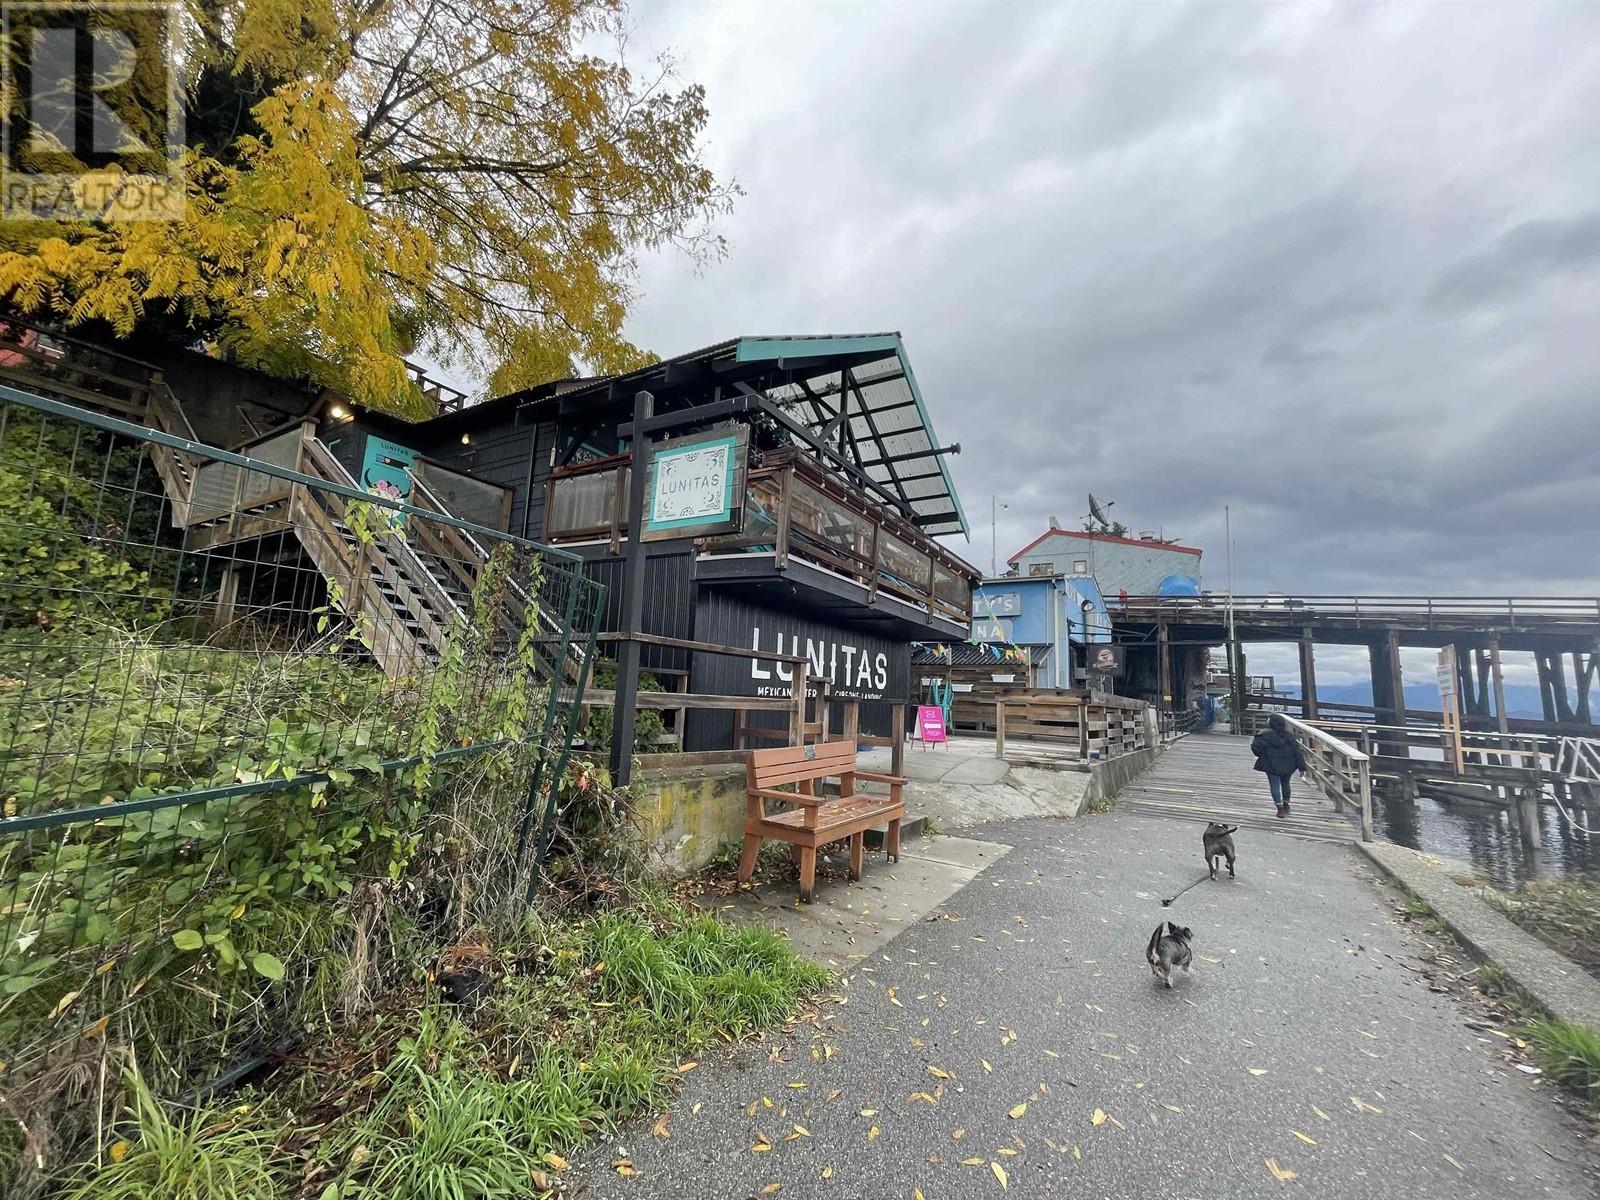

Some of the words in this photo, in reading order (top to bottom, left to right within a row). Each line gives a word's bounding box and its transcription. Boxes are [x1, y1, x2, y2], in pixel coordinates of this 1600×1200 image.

[380, 442, 409, 456] LUNITAS
[661, 474, 720, 495] LUNITAS
[973, 597, 1014, 612] TY'S
[977, 624, 1005, 640] NA
[751, 627, 888, 690] LUNITAS
[757, 686, 792, 697] MEXICAN
